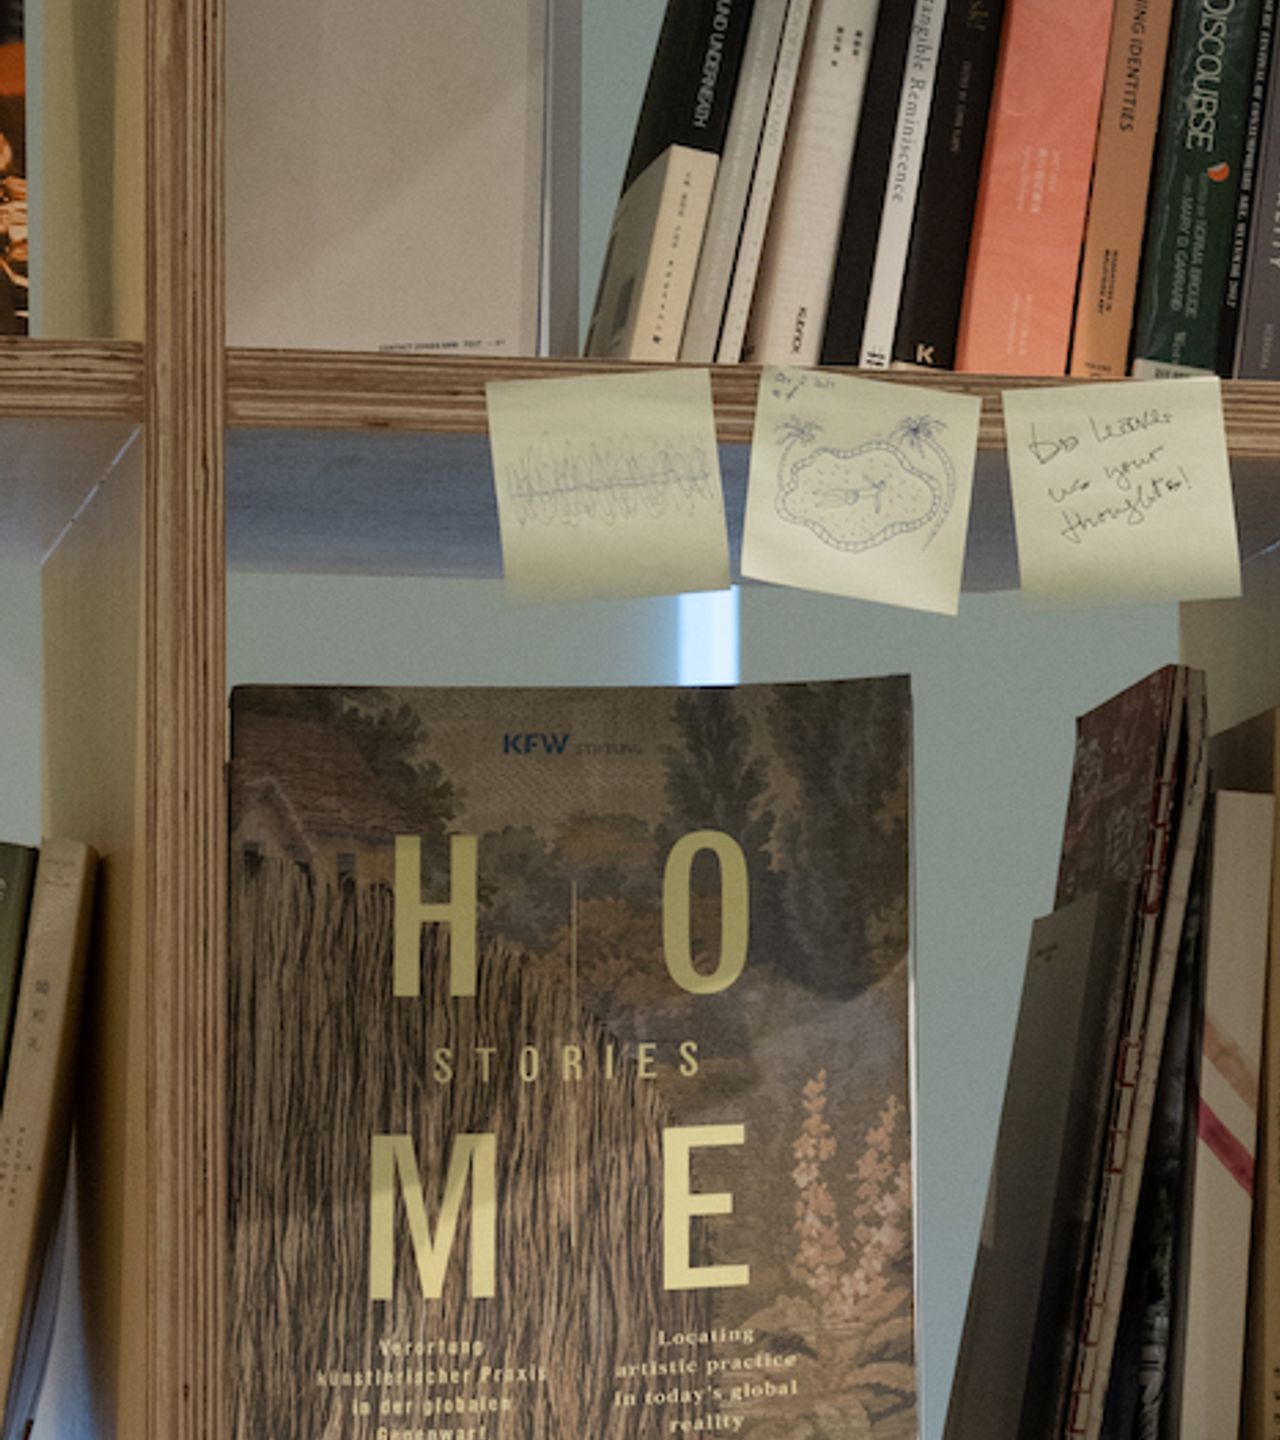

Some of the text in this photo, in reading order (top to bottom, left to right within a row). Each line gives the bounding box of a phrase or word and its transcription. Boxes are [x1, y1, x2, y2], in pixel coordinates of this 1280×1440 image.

[692, 27, 724, 131] UNDERNEATH
[1118, 37, 1147, 135] IDENTITIES
[432, 1040, 702, 1085] STORIES
[378, 1338, 485, 1358] Verortung
[657, 1326, 756, 1348] Locating
[614, 1350, 797, 1379] artistic practice
[729, 1378, 799, 1403] global
